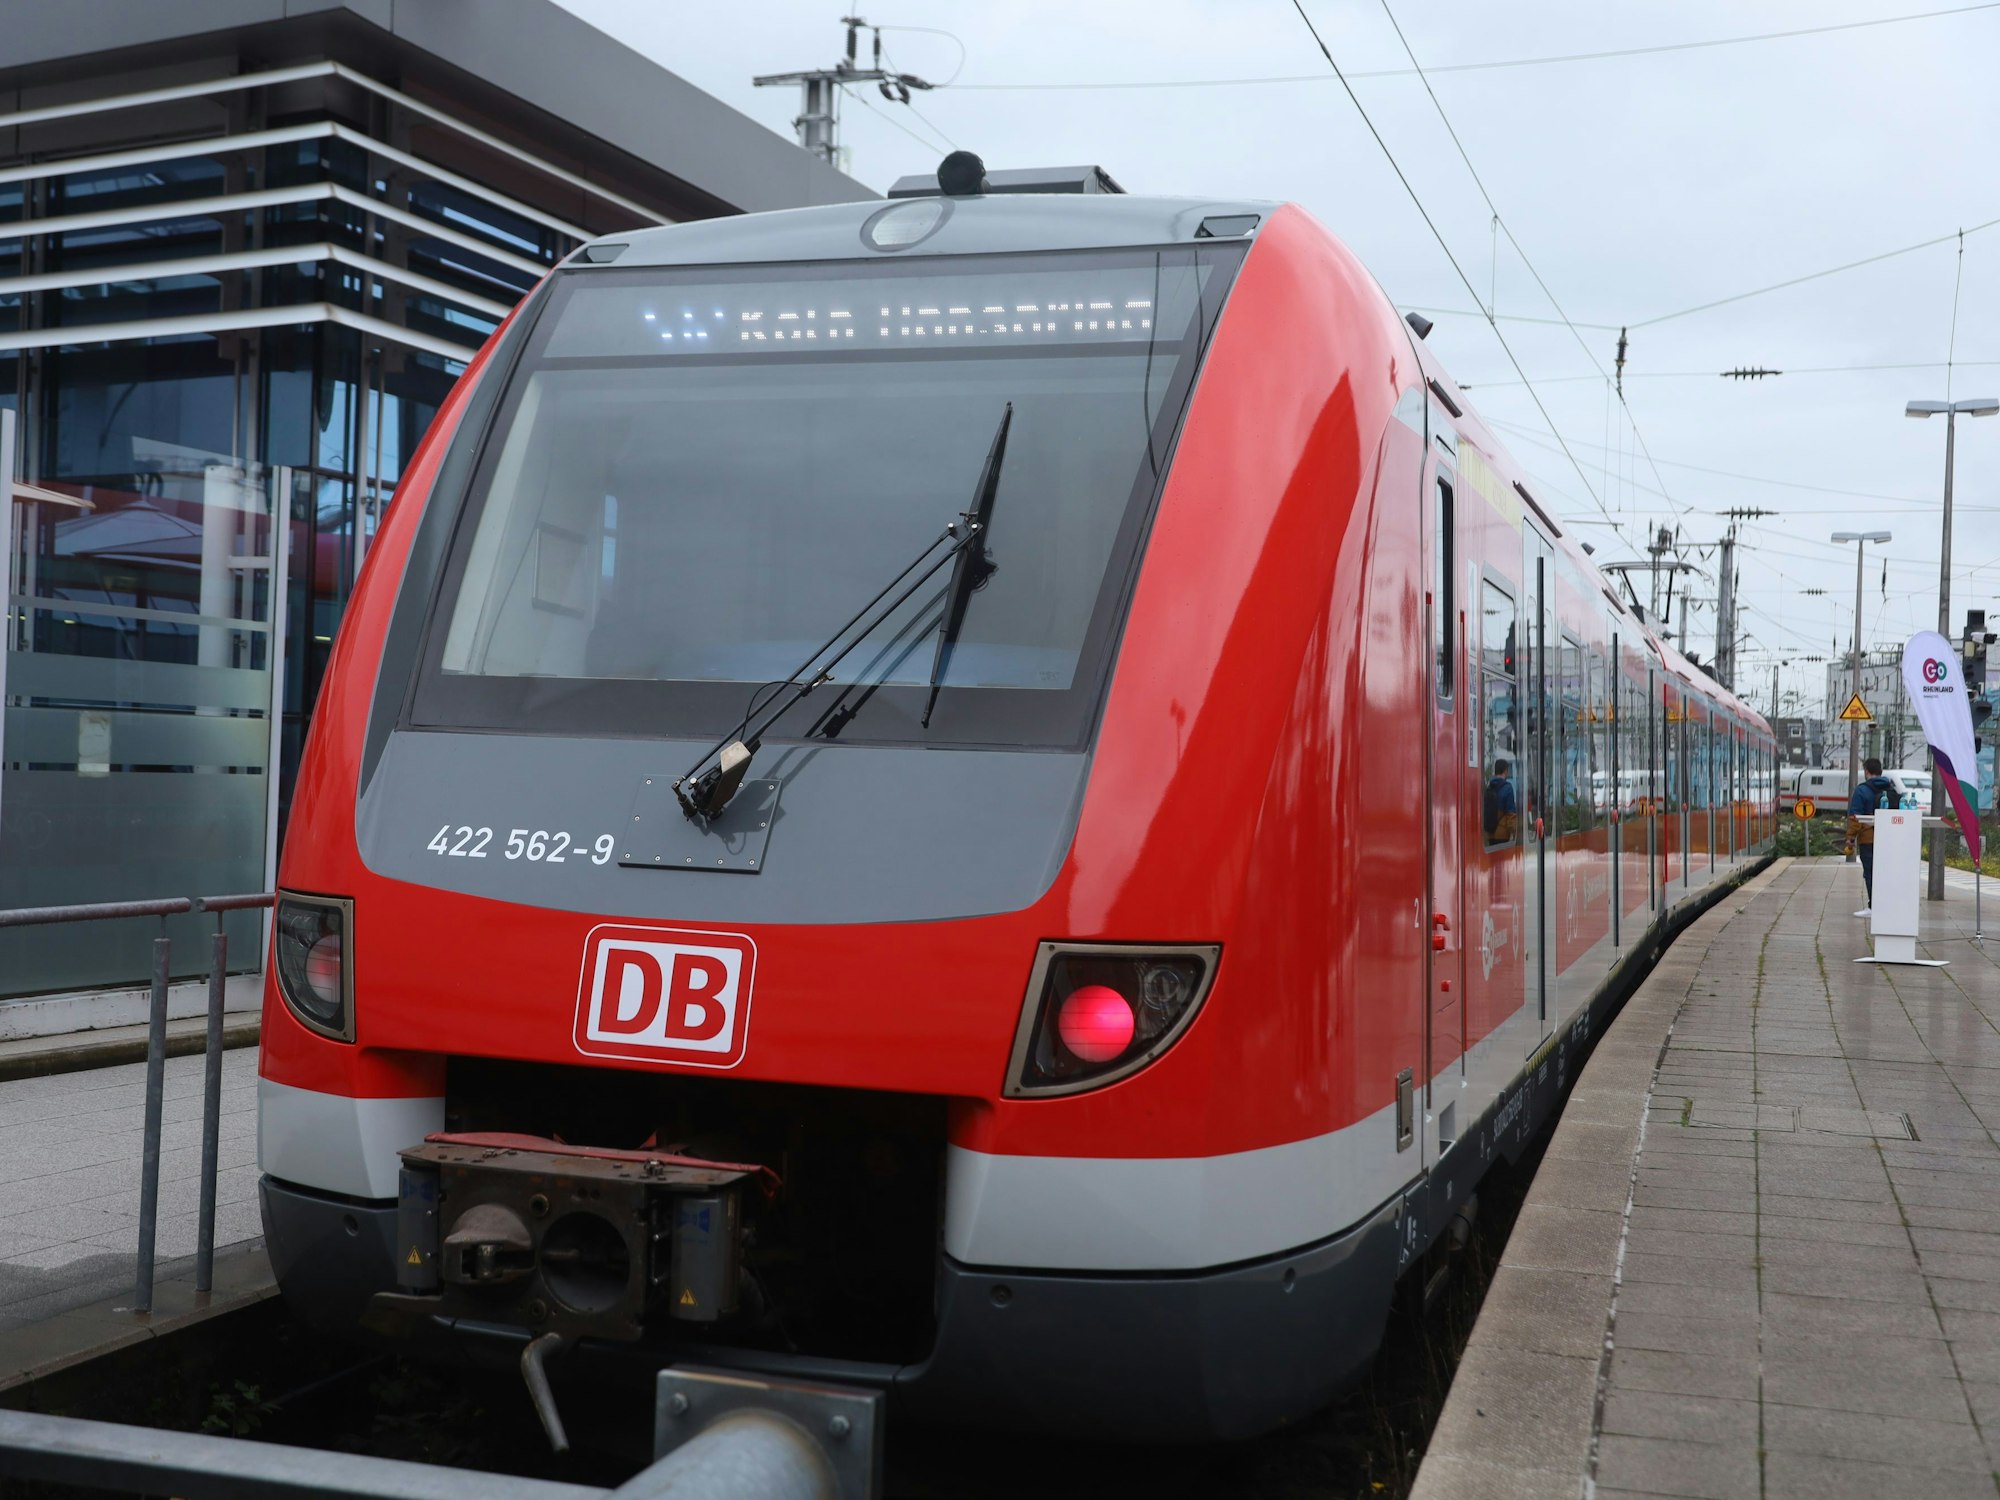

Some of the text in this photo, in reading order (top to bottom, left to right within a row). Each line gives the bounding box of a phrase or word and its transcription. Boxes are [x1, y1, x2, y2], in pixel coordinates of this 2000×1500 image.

[427, 825, 615, 865] 422 562-9
[1414, 898, 1420, 928] 2
[598, 948, 728, 1041] DB
